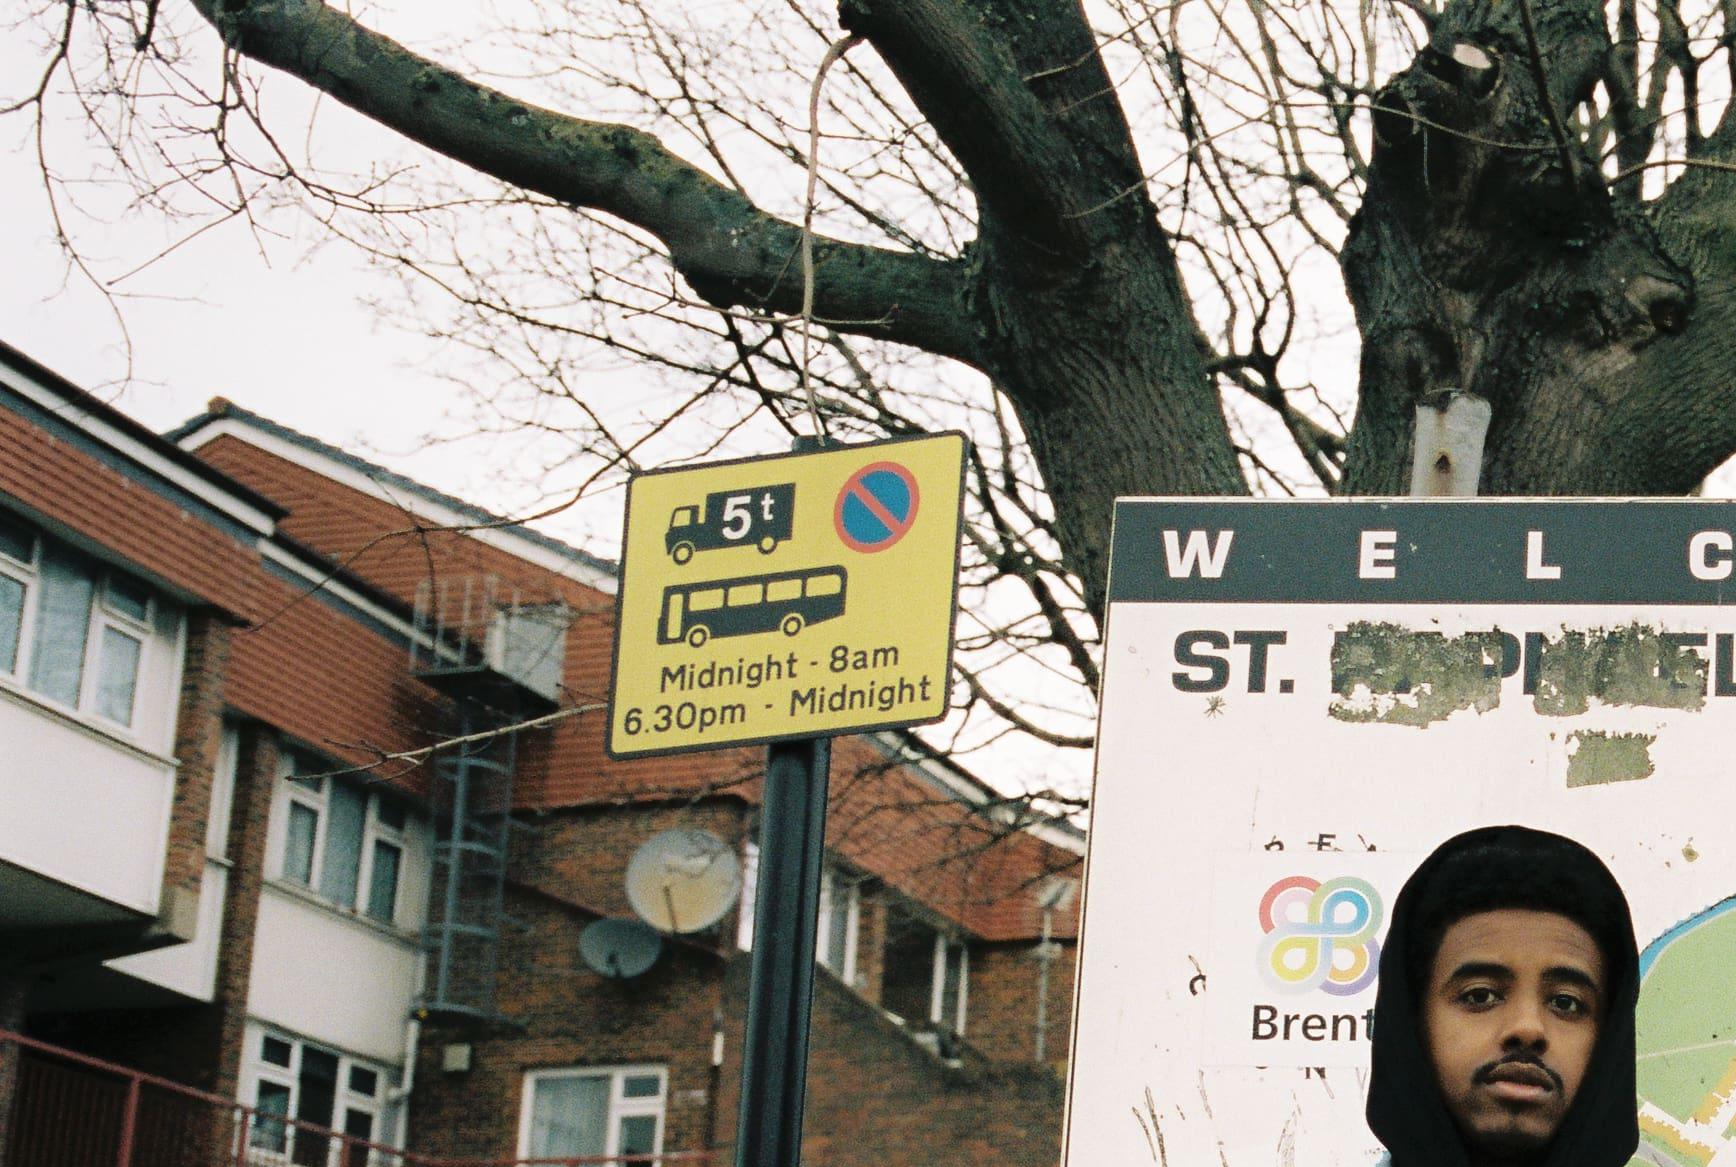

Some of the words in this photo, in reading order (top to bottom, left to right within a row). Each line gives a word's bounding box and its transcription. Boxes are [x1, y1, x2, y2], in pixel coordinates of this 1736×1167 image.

[660, 652, 798, 693] Midnight
[829, 645, 900, 673] 8am
[1171, 630, 1295, 694] ST.
[623, 701, 746, 735] 6.30pm
[789, 675, 932, 717] Midnight
